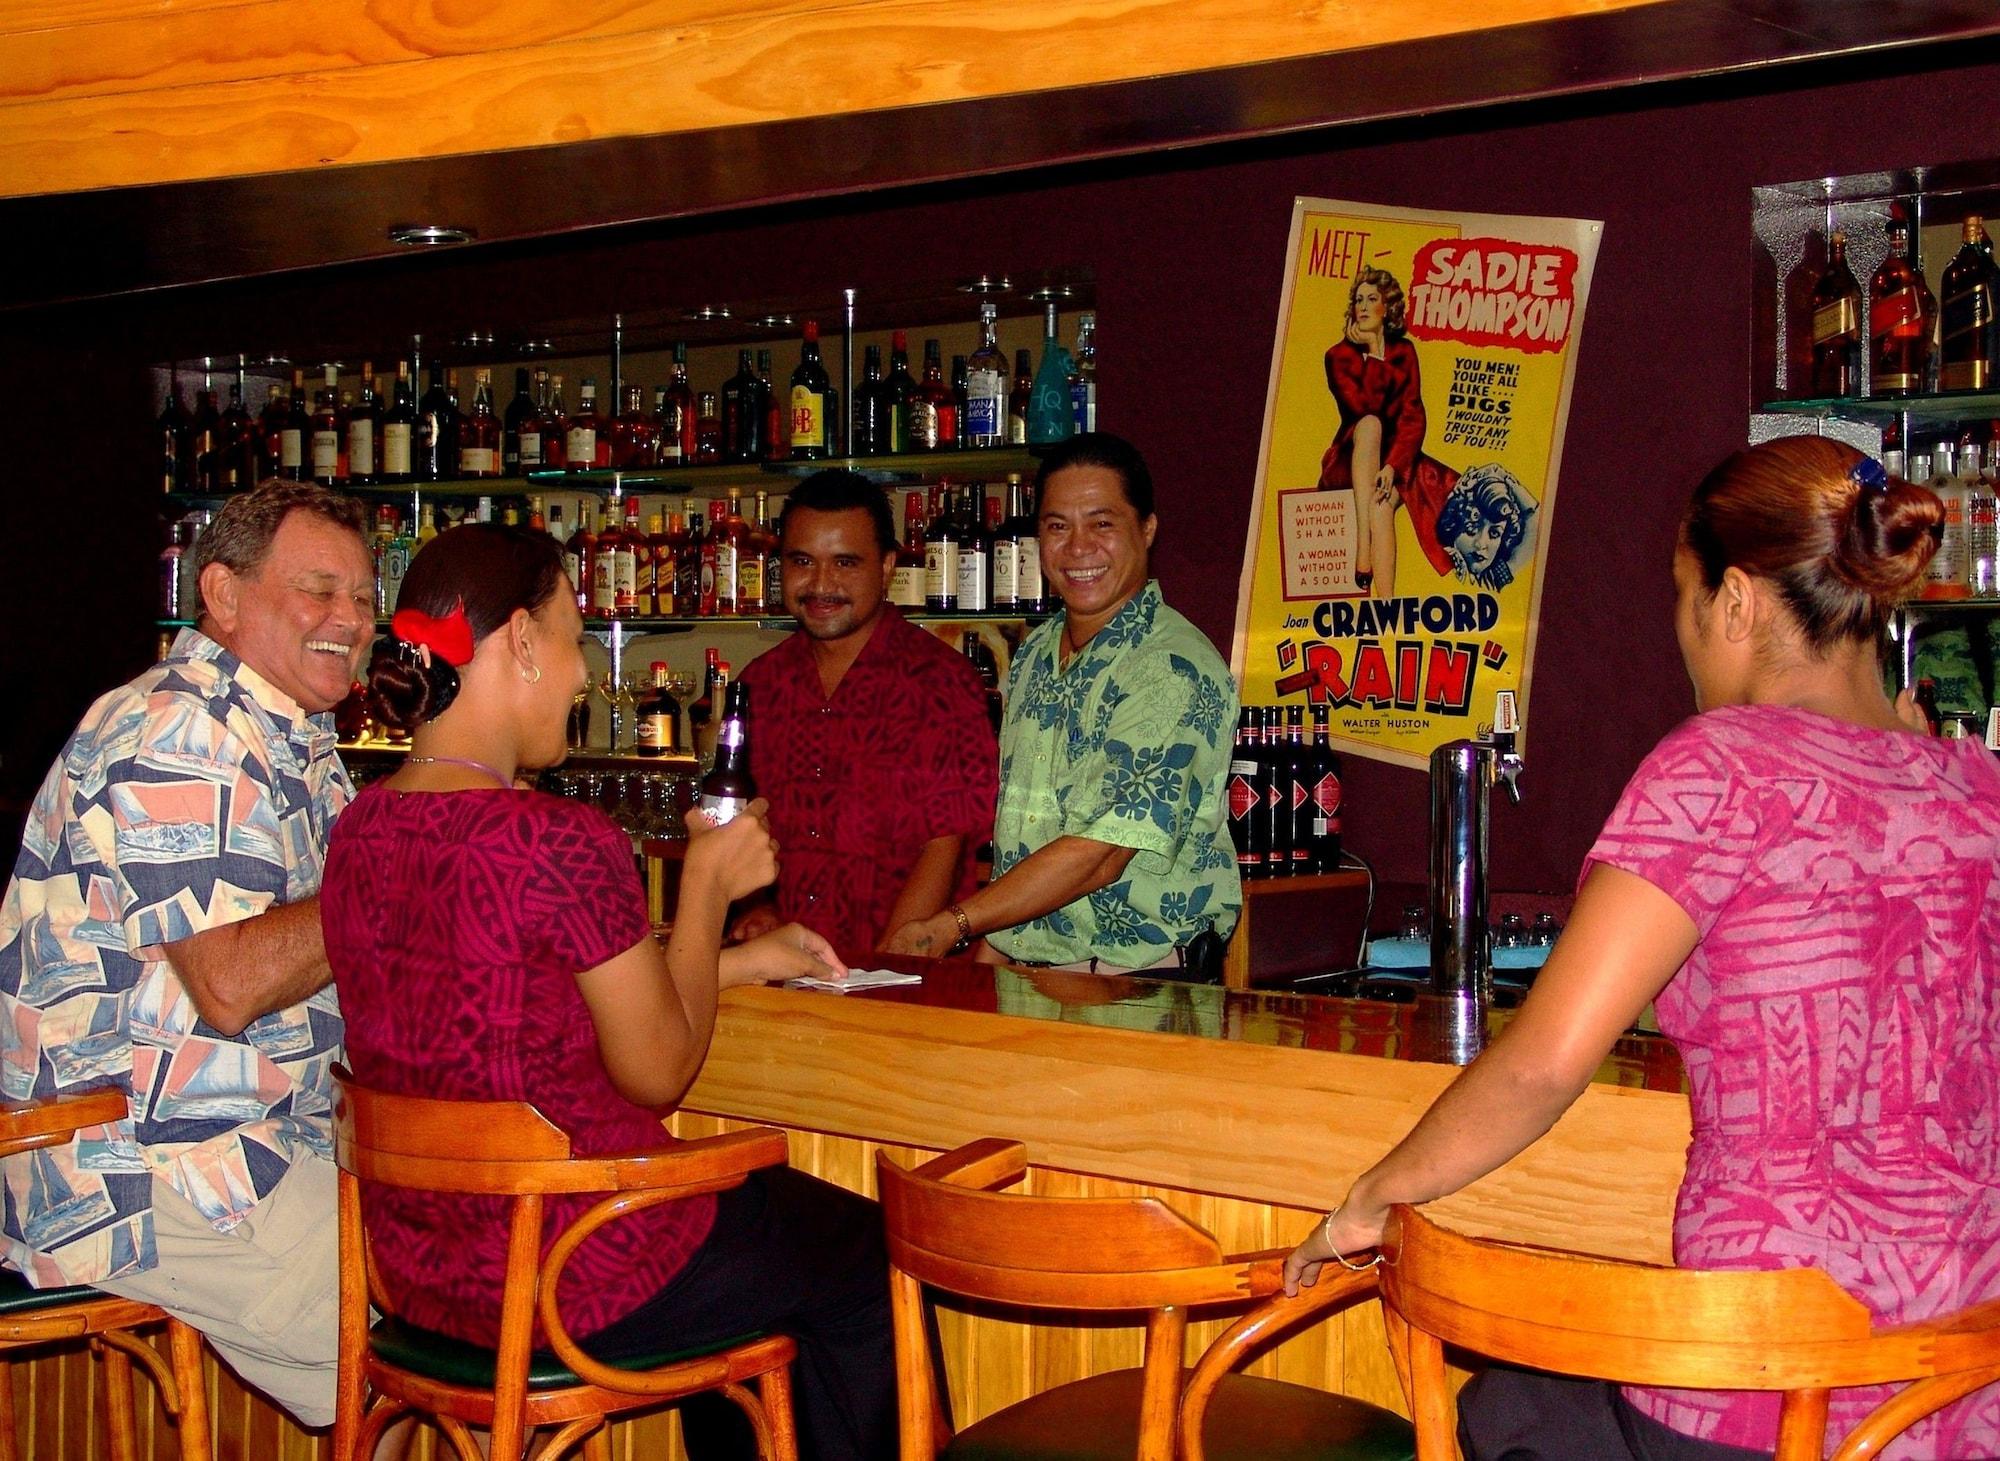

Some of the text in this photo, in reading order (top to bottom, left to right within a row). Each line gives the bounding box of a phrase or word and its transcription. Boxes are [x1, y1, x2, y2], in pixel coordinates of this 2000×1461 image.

[1308, 228, 1371, 280] MEET
[1426, 247, 1562, 297] SADIE
[1410, 284, 1572, 341] THOMPSON
[1455, 358, 1521, 376] YOU MEN!
[1497, 376, 1518, 388] ALL
[1448, 394, 1512, 414] PIGS
[1446, 409, 1513, 427] I WOULDN'T
[1445, 421, 1511, 440] TRUST ANY
[1443, 433, 1461, 444] OF
[1295, 501, 1345, 513] A WOMAN
[1295, 515, 1346, 527] WITHOUT
[1296, 527, 1346, 540] SHAME
[1298, 548, 1347, 560] A WOMAN
[1299, 561, 1348, 573] WITHOUT
[1300, 575, 1349, 586] A SOUL
[1283, 593, 1500, 639] Joan CRAWFORD
[1276, 636, 1509, 718] "RAIN"
[1343, 719, 1430, 728] WALTER HUSTON
